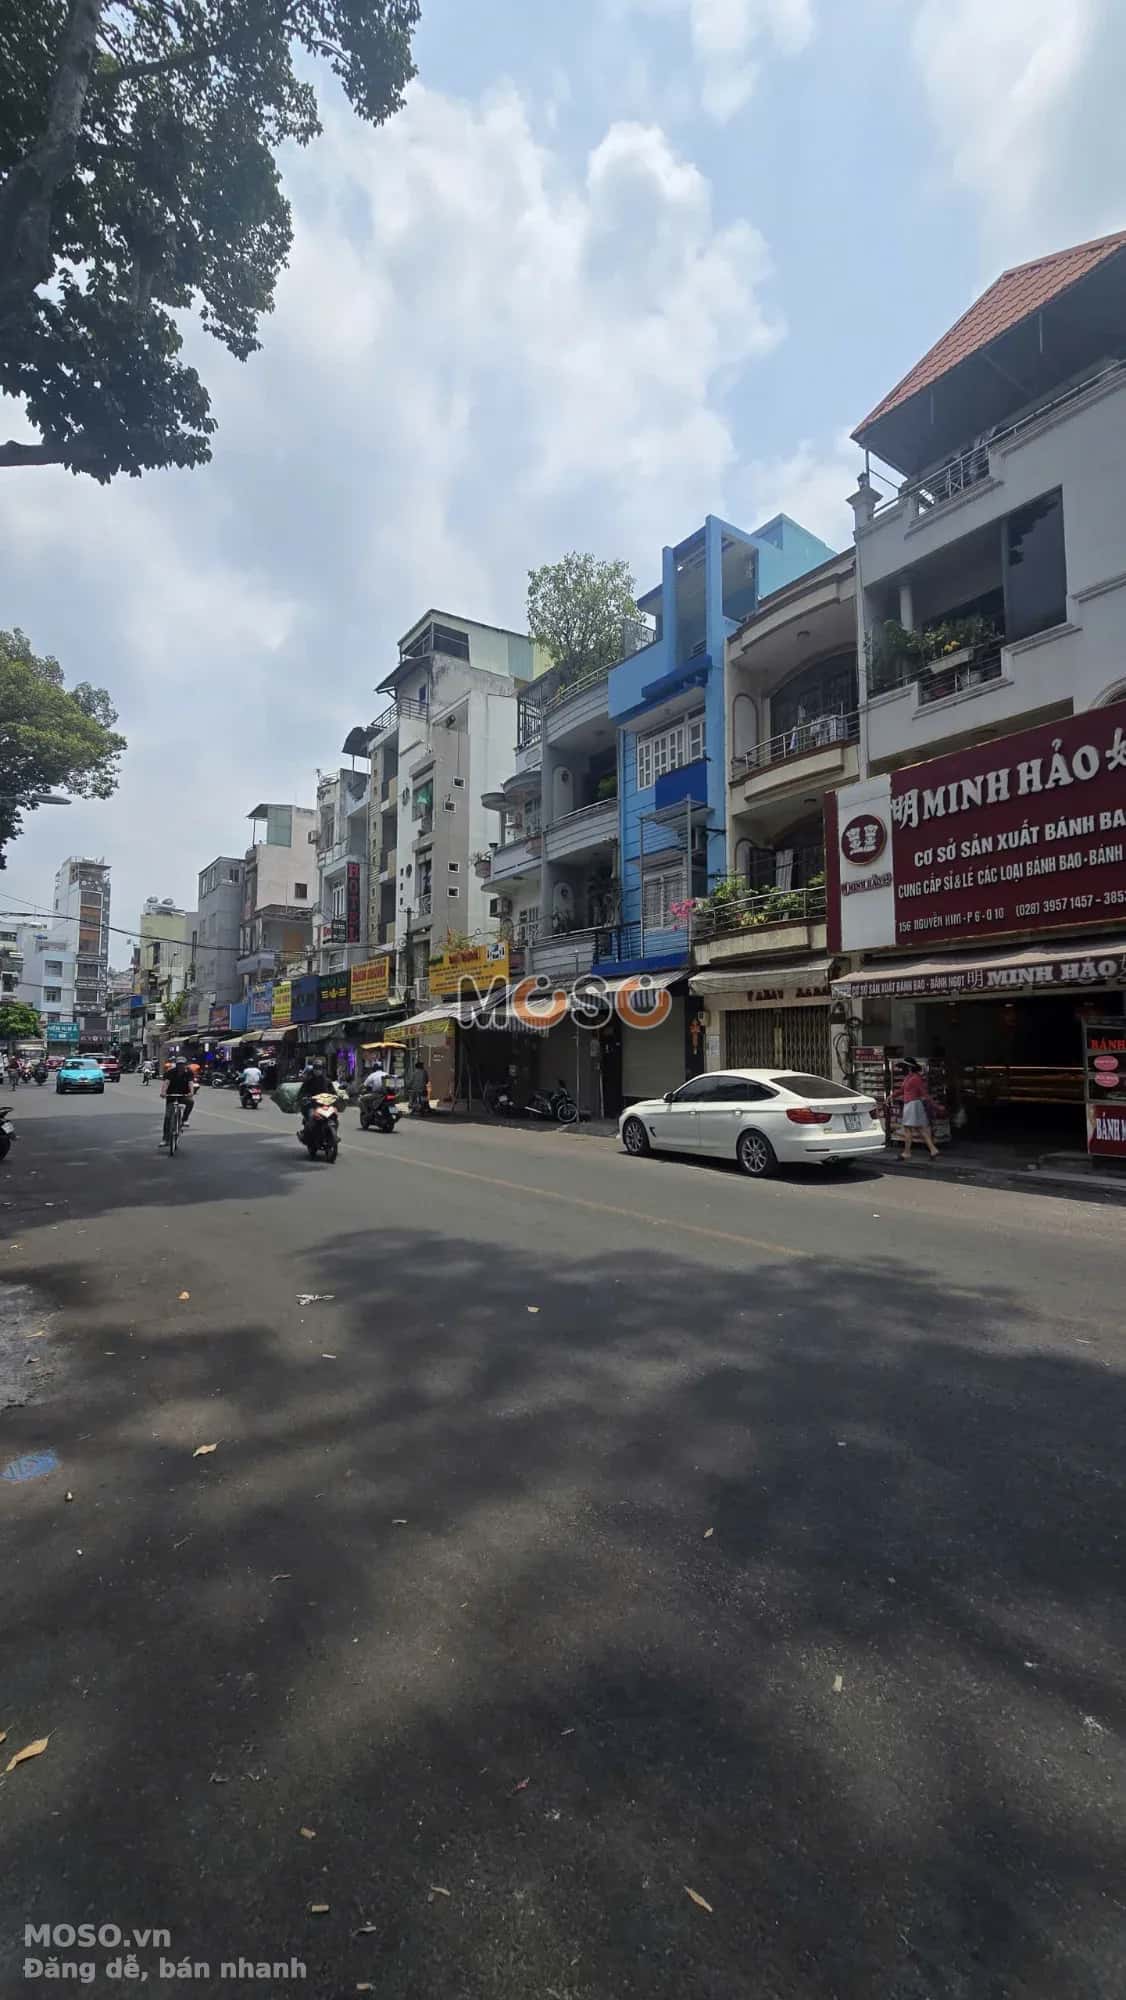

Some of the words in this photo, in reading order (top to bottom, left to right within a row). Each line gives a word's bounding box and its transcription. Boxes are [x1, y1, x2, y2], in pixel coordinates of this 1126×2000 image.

[922, 767, 1011, 820] MINH
[1016, 738, 1100, 796] HẢO
[914, 848, 933, 867] CƠ
[937, 838, 957, 863] SỞ
[961, 833, 993, 858] SẢN
[997, 819, 1040, 851] XUẤT
[1045, 816, 1095, 841] BÁNH
[898, 881, 921, 898] CUNG
[978, 865, 998, 885] CÁC
[1001, 863, 1023, 882] LOẠI
[1026, 856, 1056, 877] BÁNH
[1059, 852, 1082, 871] BAO
[1089, 843, 1123, 866] BÁNH
[1015, 902, 1040, 917] (028)
[1043, 897, 1067, 913] 3957
[967, 969, 984, 988] 明
[987, 965, 1053, 986] MINH
[1061, 956, 1117, 981] HẢO
[1096, 1112, 1120, 1141] BÁNH
